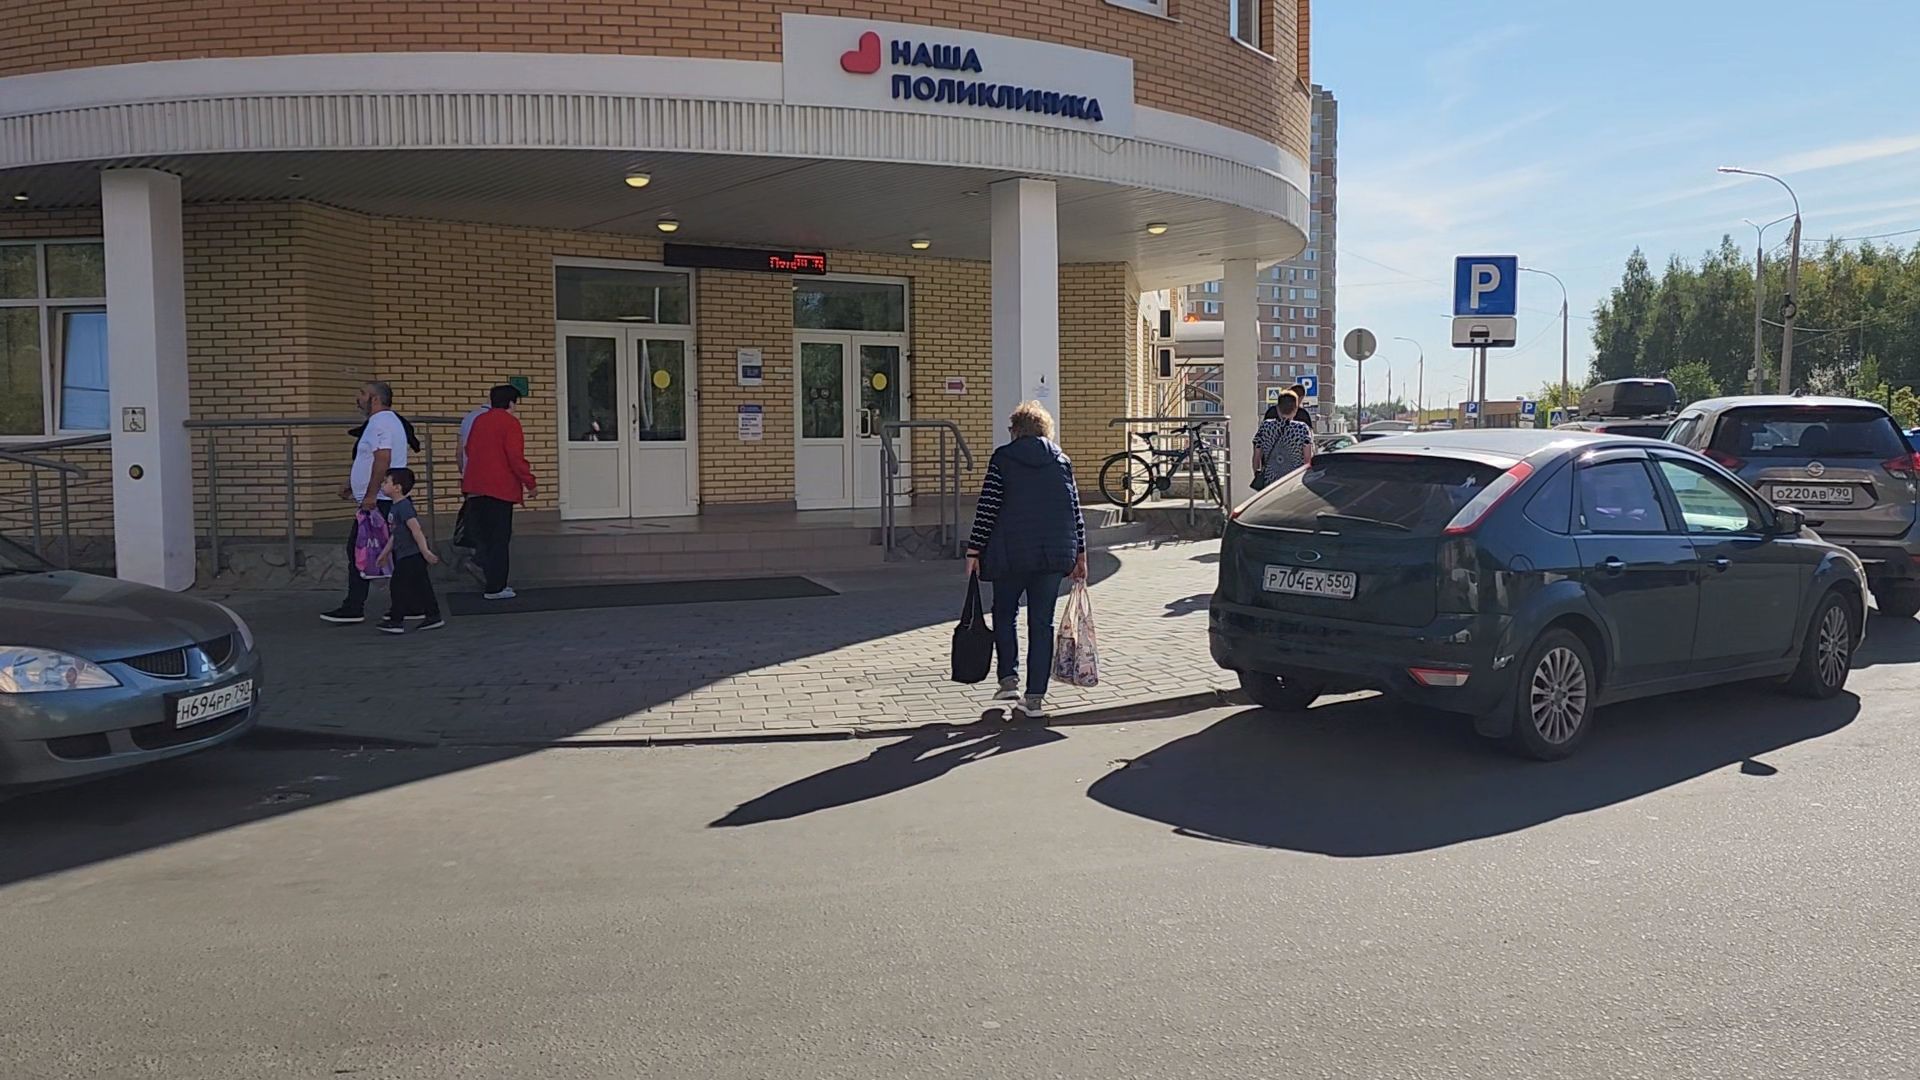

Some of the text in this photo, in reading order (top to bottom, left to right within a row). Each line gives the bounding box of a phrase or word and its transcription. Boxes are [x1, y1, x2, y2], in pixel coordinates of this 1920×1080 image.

[891, 40, 982, 73] НАША
[891, 74, 1103, 122] ПОЛИКЛИНИКА
[1470, 264, 1500, 309] P
